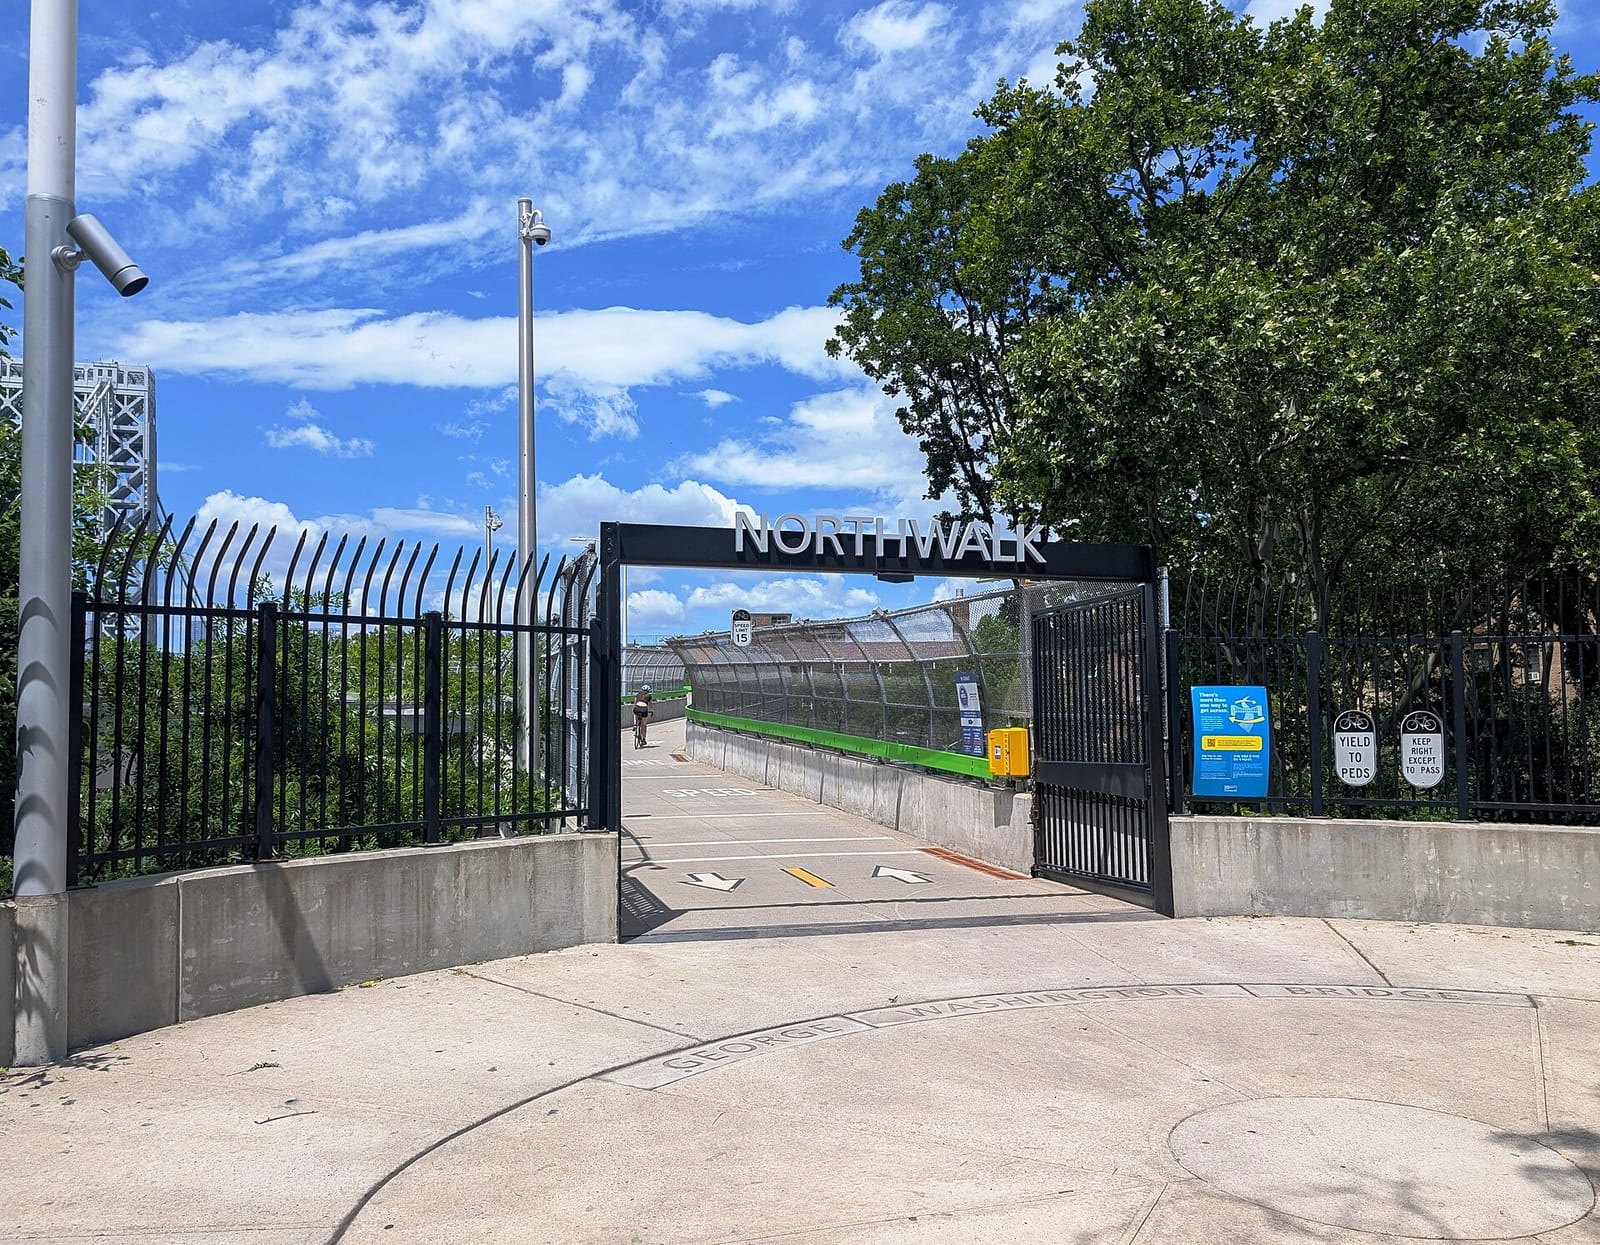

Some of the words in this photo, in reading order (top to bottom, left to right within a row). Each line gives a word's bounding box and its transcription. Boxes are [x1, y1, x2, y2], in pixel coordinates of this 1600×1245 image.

[736, 633, 748, 643] 15
[1339, 736, 1371, 747] YIELD
[1412, 738, 1431, 746] KEEP
[1348, 752, 1362, 763] TO
[1408, 757, 1437, 765] EXCEPT
[1341, 767, 1370, 779] PEDS
[1406, 766, 1416, 774] TO
[1420, 766, 1440, 774] PASS
[662, 788, 759, 798] SPEED
[662, 1021, 844, 1073] GEORGE
[902, 986, 1204, 1018] WASHINGTON
[1283, 985, 1459, 999] BRIDGE
